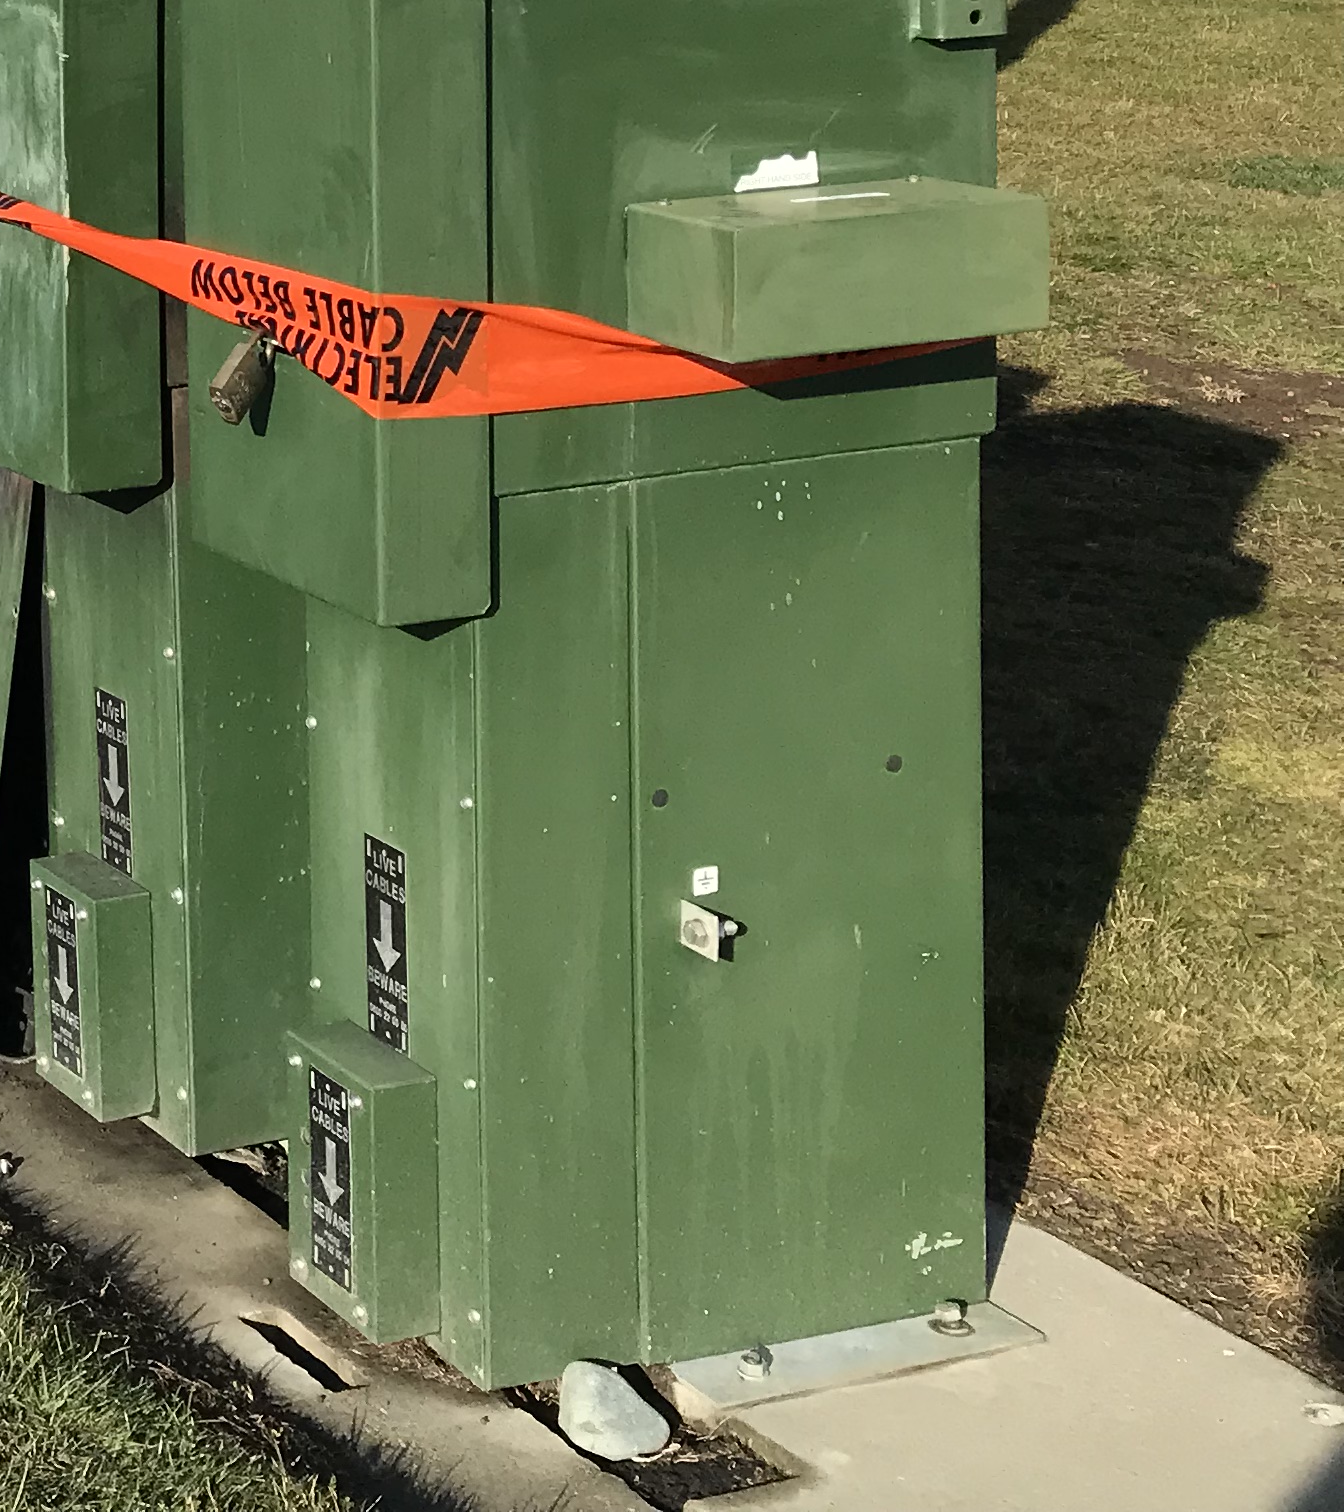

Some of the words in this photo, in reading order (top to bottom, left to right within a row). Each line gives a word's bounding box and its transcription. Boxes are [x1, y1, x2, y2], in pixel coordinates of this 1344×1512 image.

[191, 259, 297, 321] BELOW
[303, 286, 405, 353] CABLE
[101, 701, 121, 723] LIVE
[96, 718, 127, 746] CABLES
[372, 850, 397, 878] LIVE
[365, 869, 406, 904] CABLES
[367, 964, 408, 1003] BEWARE
[318, 1088, 341, 1117] LIVE
[311, 1105, 349, 1143] CABLES
[313, 1197, 350, 1238] BEWARE
